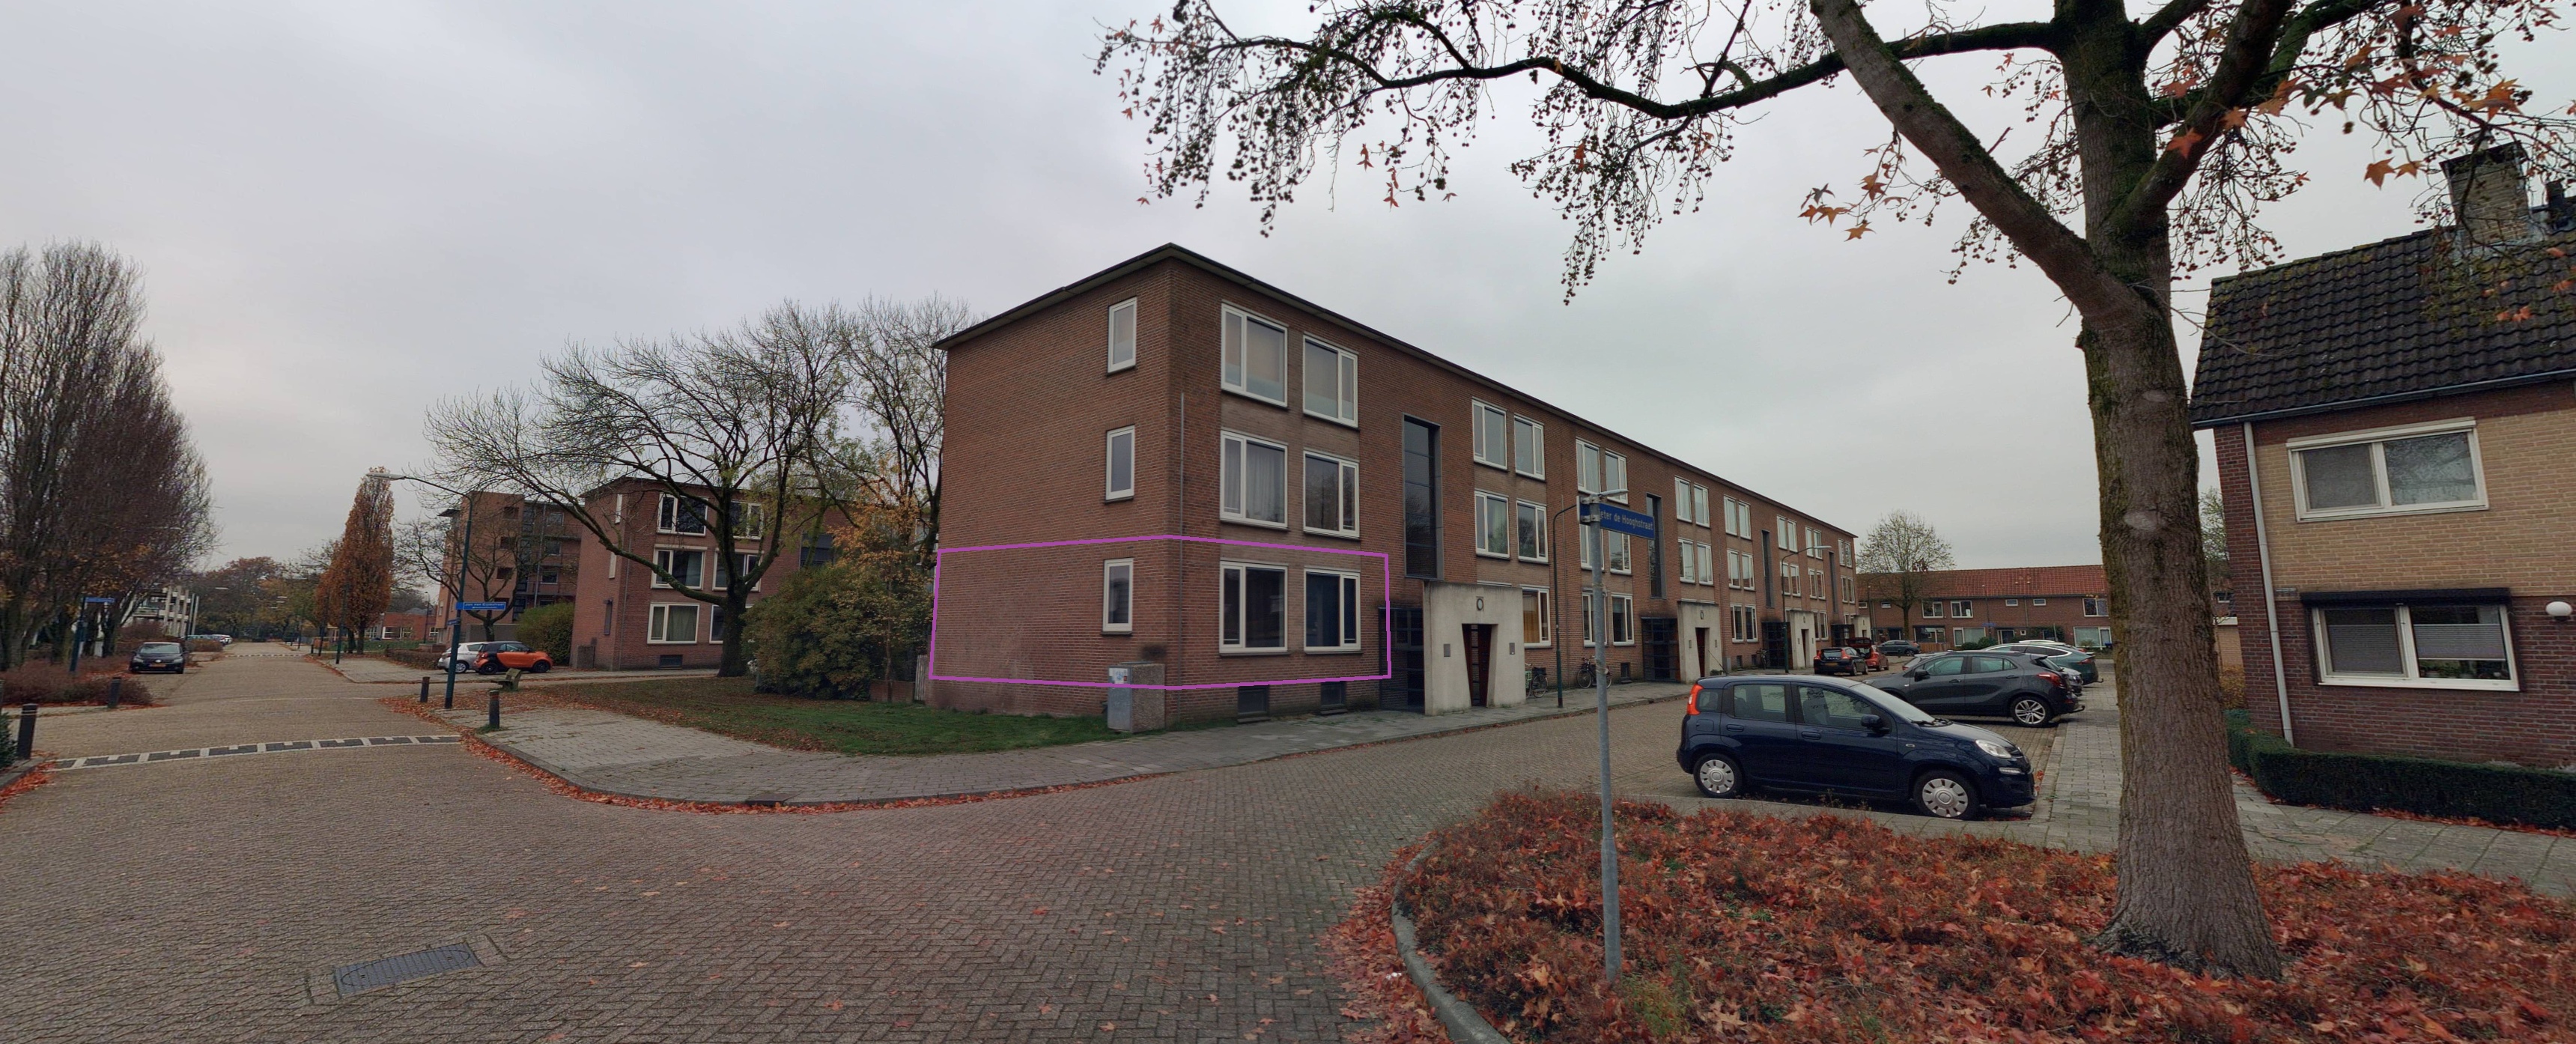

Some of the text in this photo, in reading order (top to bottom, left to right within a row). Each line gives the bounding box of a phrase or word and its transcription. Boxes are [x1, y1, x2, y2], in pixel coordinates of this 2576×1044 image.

[1600, 510, 1653, 530] eter de Hooghstraat
